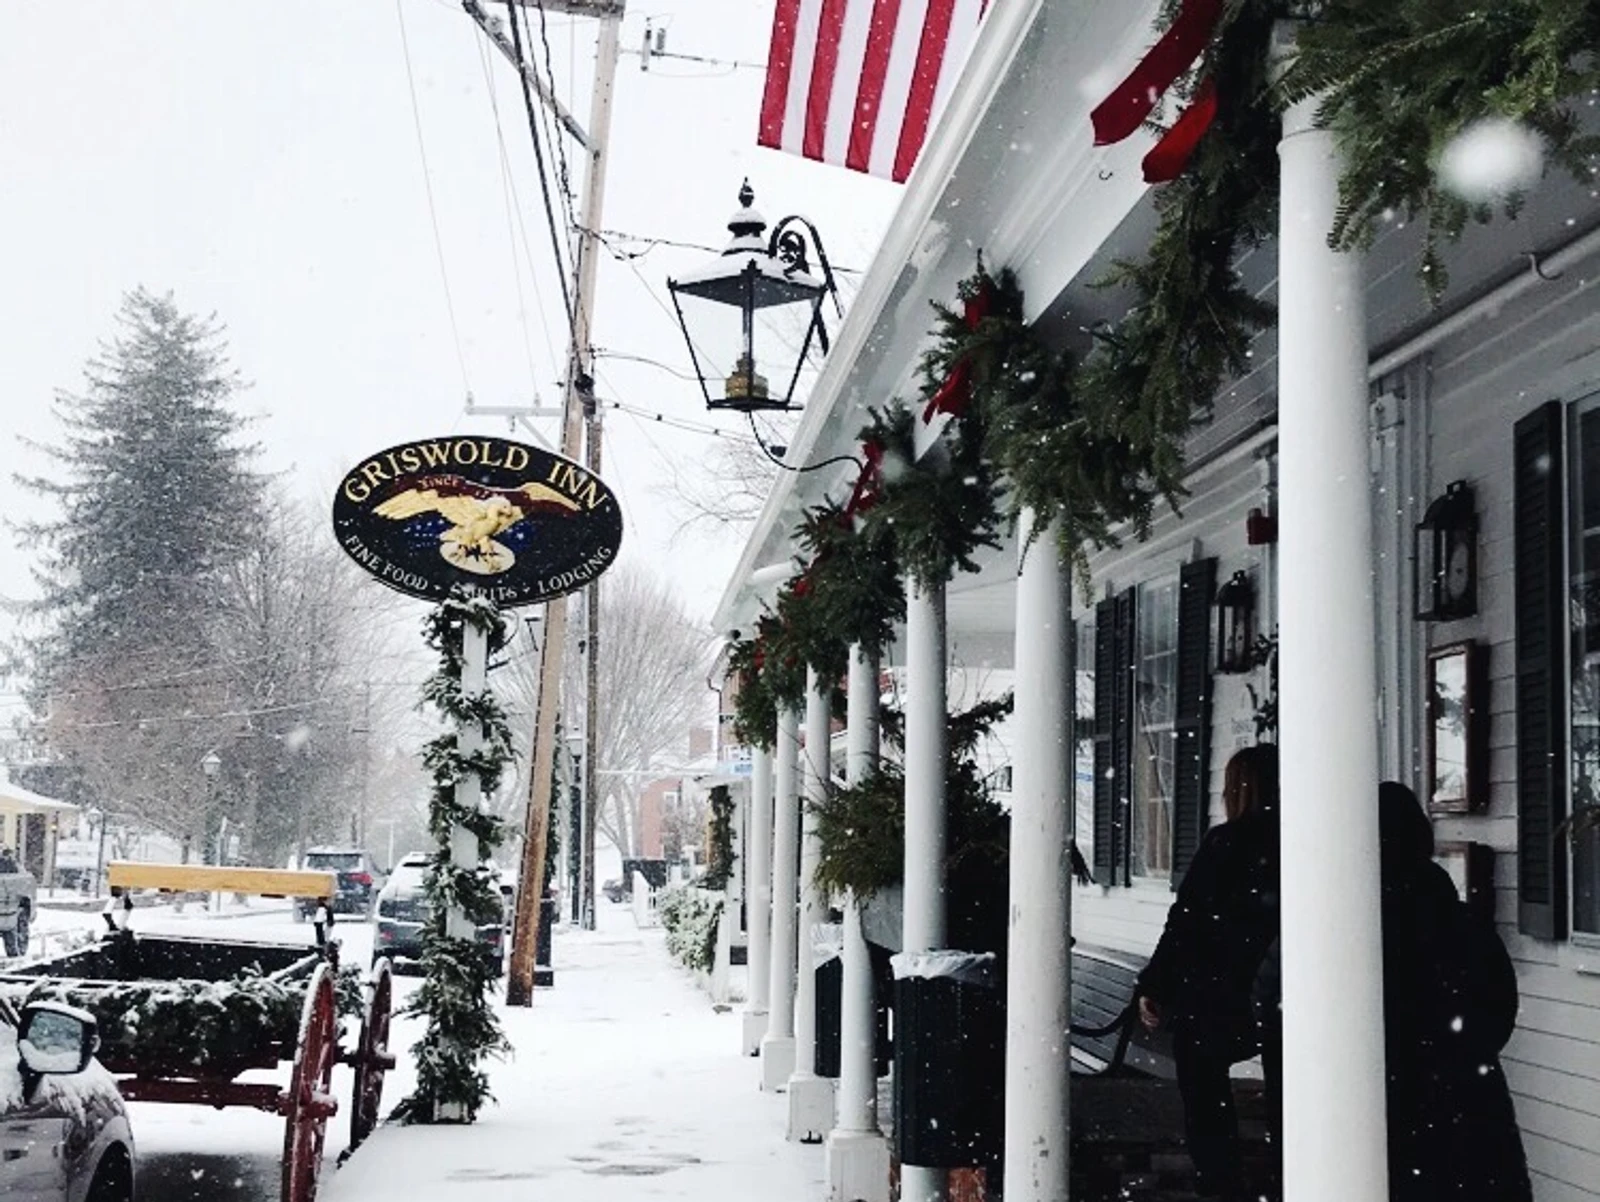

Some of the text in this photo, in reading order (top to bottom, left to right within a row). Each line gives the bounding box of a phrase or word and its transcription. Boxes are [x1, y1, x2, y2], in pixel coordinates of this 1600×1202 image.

[345, 439, 609, 510] GRISWOLD INN
[345, 535, 382, 571] FINE
[382, 563, 428, 590] FOOD
[538, 545, 612, 594] LODGING
